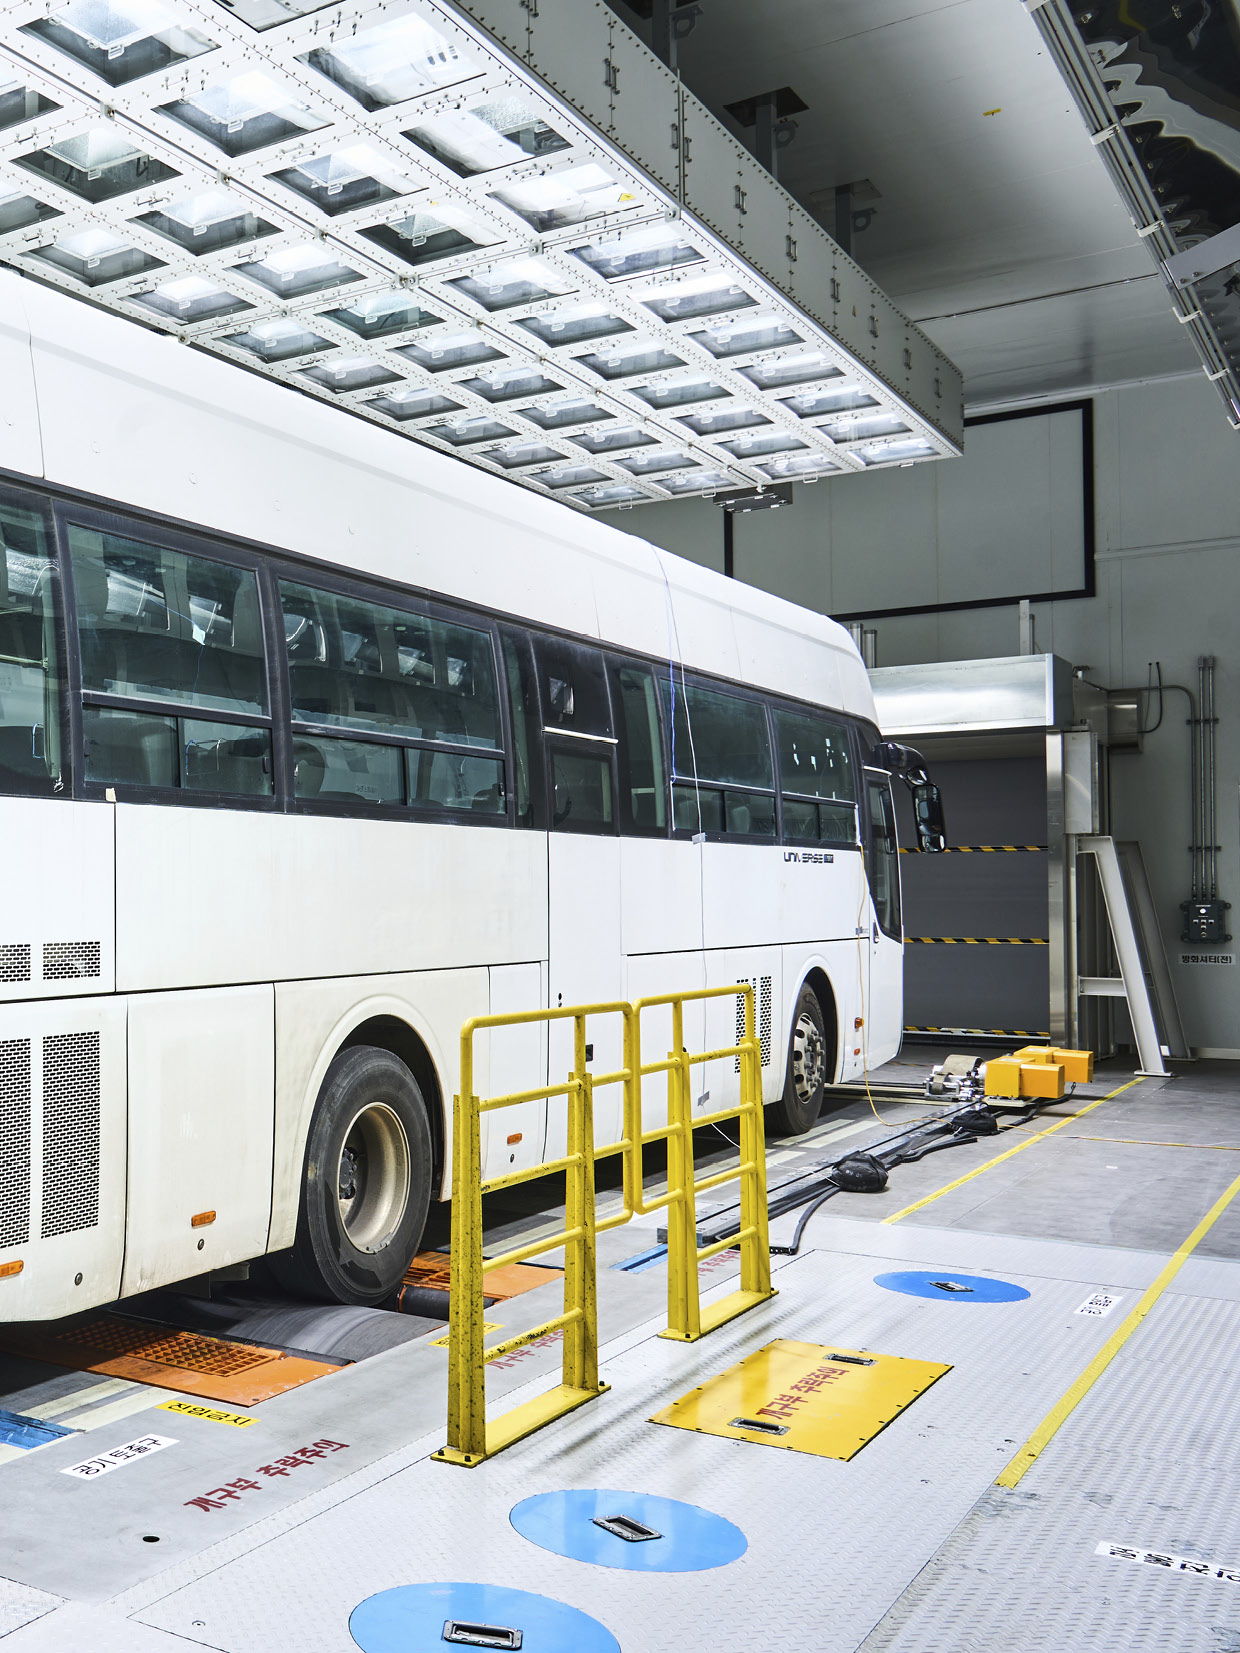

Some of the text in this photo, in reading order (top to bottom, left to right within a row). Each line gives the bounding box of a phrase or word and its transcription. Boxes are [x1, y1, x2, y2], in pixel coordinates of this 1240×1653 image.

[167, 1402, 252, 1426] 진입금지
[755, 1365, 850, 1420] 개구부 추락주의
[71, 1437, 162, 1476] 공기 토출구
[182, 1438, 351, 1512] 개구부 추락주의
